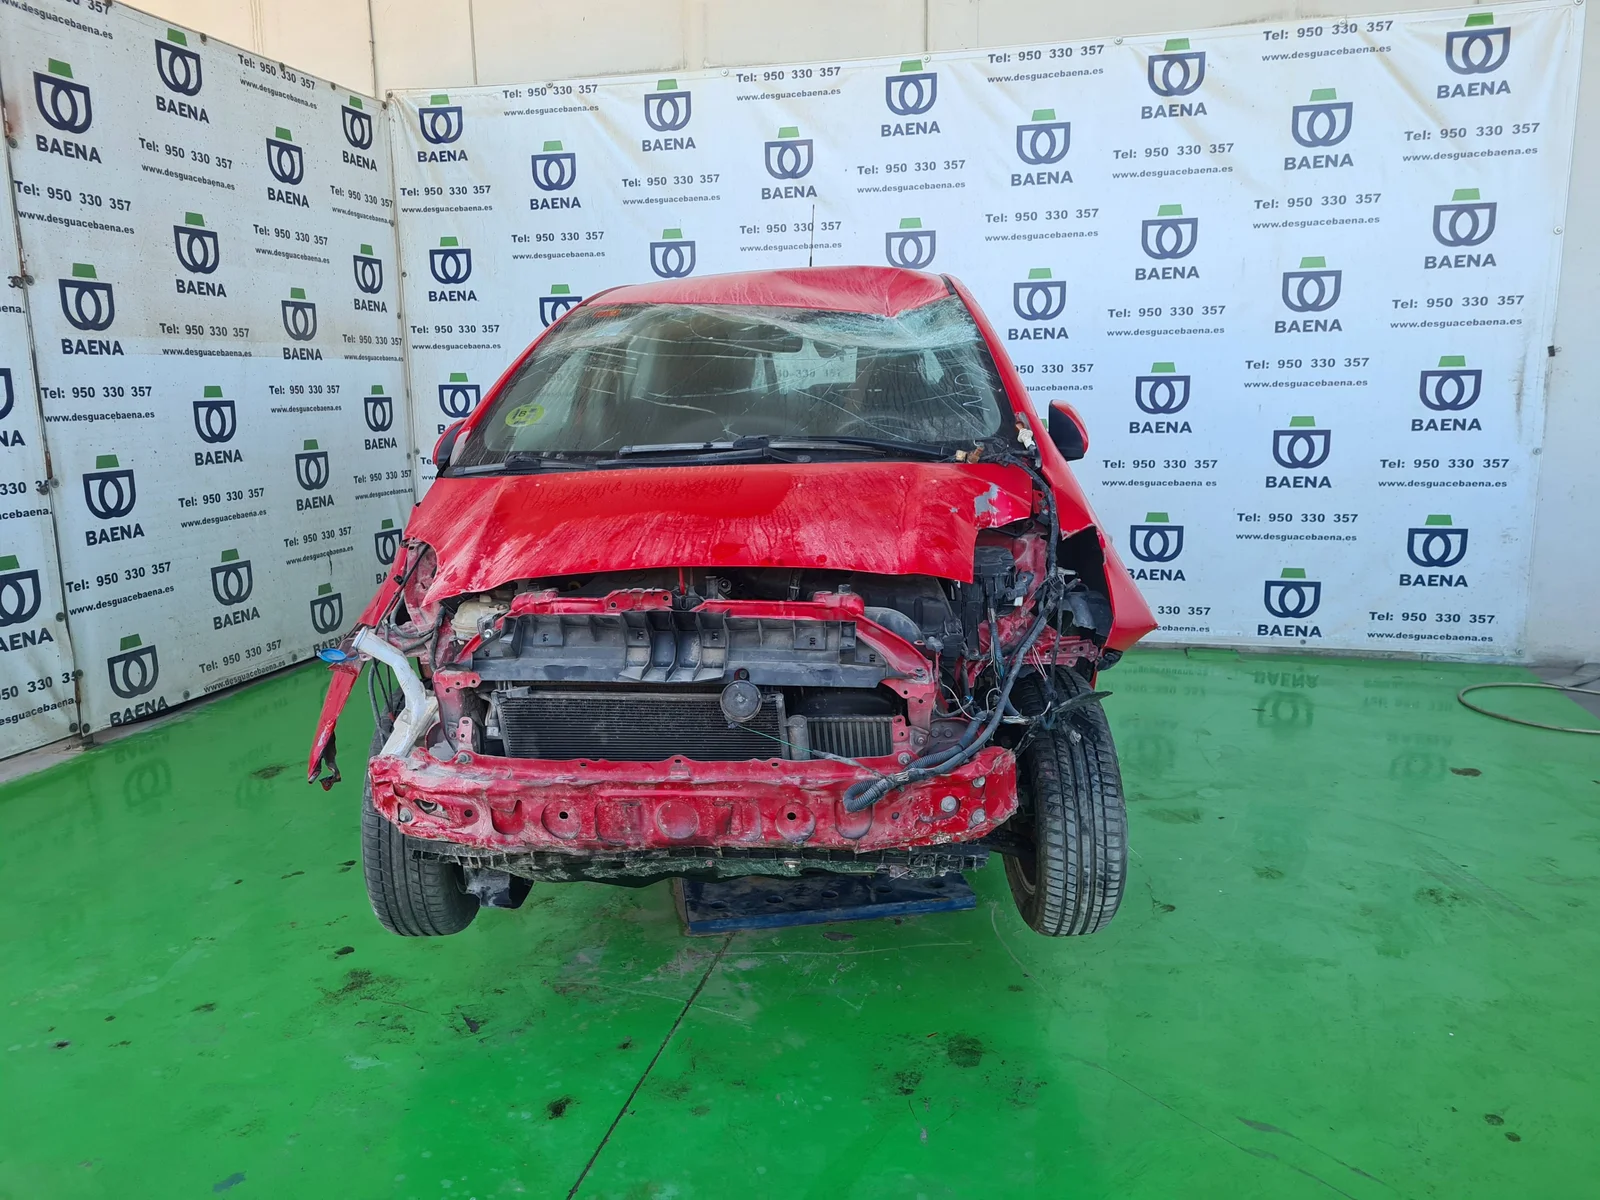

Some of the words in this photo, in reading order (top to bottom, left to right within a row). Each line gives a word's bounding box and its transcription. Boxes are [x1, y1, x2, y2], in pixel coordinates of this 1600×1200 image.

[988, 53, 1010, 63] Tel:
[1018, 50, 1041, 61] 950
[1049, 48, 1072, 58] 330
[1081, 44, 1104, 56] 357
[736, 73, 757, 82] Tel:
[764, 71, 784, 81] 950
[792, 69, 812, 79] 330
[820, 66, 841, 77] 357
[987, 68, 1103, 82] www.desguacebaena.es
[737, 89, 841, 101] www.desguacebaena.es
[1437, 80, 1511, 99] BAENA
[156, 95, 210, 124] BAENA
[1141, 102, 1207, 119] BAENA
[881, 121, 940, 137] BAENA
[1404, 130, 1431, 141] Tel:
[1440, 128, 1466, 138] 950
[1476, 126, 1503, 136] 330
[1512, 123, 1540, 134] 357
[36, 134, 102, 164] BAENA
[642, 137, 696, 152] BAENA
[1113, 149, 1136, 159] Tel:
[1145, 147, 1168, 158] 950
[1177, 145, 1201, 156] 330
[1210, 143, 1234, 154] 357
[138, 137, 159, 152] Tel:
[165, 144, 185, 158] 950
[191, 150, 210, 164] 330
[216, 156, 232, 169] 357
[418, 150, 468, 162] BAENA
[342, 150, 377, 172] BAENA
[857, 165, 878, 175] Tel:
[886, 163, 907, 173] 950
[914, 162, 936, 171] 330
[944, 160, 965, 170] 357
[1284, 154, 1354, 170] BAENA
[141, 164, 235, 190] www.desguacebaena.es
[1011, 171, 1073, 186] BAENA
[1112, 166, 1233, 178] www.desguacebaena.es
[622, 178, 641, 187] Tel:
[647, 177, 667, 186] 950
[674, 176, 693, 184] 330
[700, 174, 720, 183] 357
[857, 182, 965, 193] www.desguacebaena.es
[14, 180, 40, 196] Tel:
[47, 187, 72, 202] 950
[79, 192, 102, 207] 330
[109, 198, 131, 211] 357
[267, 187, 310, 208] BAENA
[400, 188, 419, 196] Tel:
[424, 187, 443, 196] 950
[449, 186, 467, 195] 330
[473, 185, 491, 194] 357
[762, 186, 818, 200] BAENA
[530, 196, 581, 210] BAENA
[623, 195, 720, 204] www.desguacebaena.es
[401, 206, 492, 214] www.desguacebaena.es
[985, 214, 1007, 223] Tel:
[1015, 212, 1037, 221] 950
[1046, 210, 1068, 220] 330
[1076, 208, 1099, 218] 357
[18, 210, 134, 234] www.desguacebaena.es
[253, 224, 270, 236] Tel:
[274, 228, 290, 239] 950
[295, 232, 310, 242] 330
[314, 235, 328, 246] 357
[511, 234, 530, 243] Tel:
[536, 233, 554, 242] 950
[561, 232, 579, 241] 330
[586, 232, 604, 240] 357
[985, 231, 1098, 241] www.desguacebaena.es
[255, 248, 330, 264] www.desguacebaena.es
[512, 251, 605, 260] www.desguacebaena.es
[1424, 254, 1496, 269] BAENA
[1135, 266, 1200, 280] BAENA
[176, 279, 227, 298] BAENA
[428, 290, 477, 302] BAENA
[1392, 299, 1418, 309] Tel:
[1427, 298, 1453, 308] 950
[1462, 296, 1488, 306] 330
[1497, 295, 1524, 305] 357
[354, 298, 387, 313] BAENA
[1108, 308, 1130, 318] Tel:
[1138, 308, 1162, 317] 950
[1170, 306, 1193, 316] 330
[1202, 306, 1226, 315] 357
[159, 323, 180, 334] Tel:
[185, 324, 204, 335] 950
[210, 326, 228, 336] 330
[233, 328, 249, 338] 357
[410, 326, 429, 334] Tel:
[434, 325, 452, 333] 950
[458, 325, 476, 333] 330
[482, 325, 500, 333] 357
[1275, 319, 1342, 333] BAENA
[1390, 319, 1522, 328] www.desguacebaena.es
[1008, 327, 1069, 340] BAENA
[1107, 328, 1224, 337] www.desguacebaena.es
[61, 338, 124, 356] BAENA
[162, 348, 252, 357] www.desguacebaena.es
[283, 347, 322, 360] BAENA
[412, 343, 501, 351] www.desguacebaena.es
[1245, 360, 1269, 369] Tel:
[1278, 359, 1302, 368] 950
[1311, 358, 1336, 368] 330
[1344, 358, 1369, 367] 357
[269, 386, 285, 394] Tel:
[289, 385, 304, 394] 950
[308, 385, 322, 394] 330
[327, 385, 340, 394] 357
[1244, 380, 1368, 388] www.desguacebaena.es
[42, 387, 66, 399] Tel:
[72, 387, 95, 398] 950
[102, 386, 124, 398] 330
[131, 386, 152, 397] 357
[270, 405, 342, 414] www.desguacebaena.es
[45, 411, 155, 423] www.desguacebaena.es
[1129, 421, 1192, 434] BAENA
[1411, 418, 1482, 431] BAENA
[364, 437, 397, 450] BAENA
[194, 449, 243, 466] BAENA
[1266, 476, 1332, 488] BAENA
[178, 496, 198, 508] Tel:
[202, 493, 221, 504] 950
[226, 490, 243, 501] 330
[248, 488, 264, 498] 357
[296, 494, 334, 511] BAENA
[181, 510, 266, 528] www.desguacebaena.es
[1237, 513, 1260, 522] Tel:
[1268, 513, 1292, 522] 950
[1301, 514, 1325, 522] 330
[1334, 514, 1358, 523] 357
[85, 523, 145, 546] BAENA
[1236, 533, 1356, 542] www.desguacebaena.es
[66, 579, 89, 592] Tel:
[96, 572, 118, 587] 950
[124, 567, 145, 580] 330
[152, 562, 171, 574] 357
[1399, 574, 1468, 587] BAENA
[69, 585, 175, 616] www.desguacebaena.es
[213, 607, 260, 630] BAENA
[1369, 612, 1393, 620] Tel:
[1402, 612, 1427, 622] 950
[1435, 613, 1460, 622] 330
[1469, 614, 1495, 624] 357
[1258, 624, 1322, 639] BAENA
[1367, 632, 1493, 642] www.desguacebaena.es
[0, 627, 54, 652] AENA
[110, 696, 169, 726] BAENA
